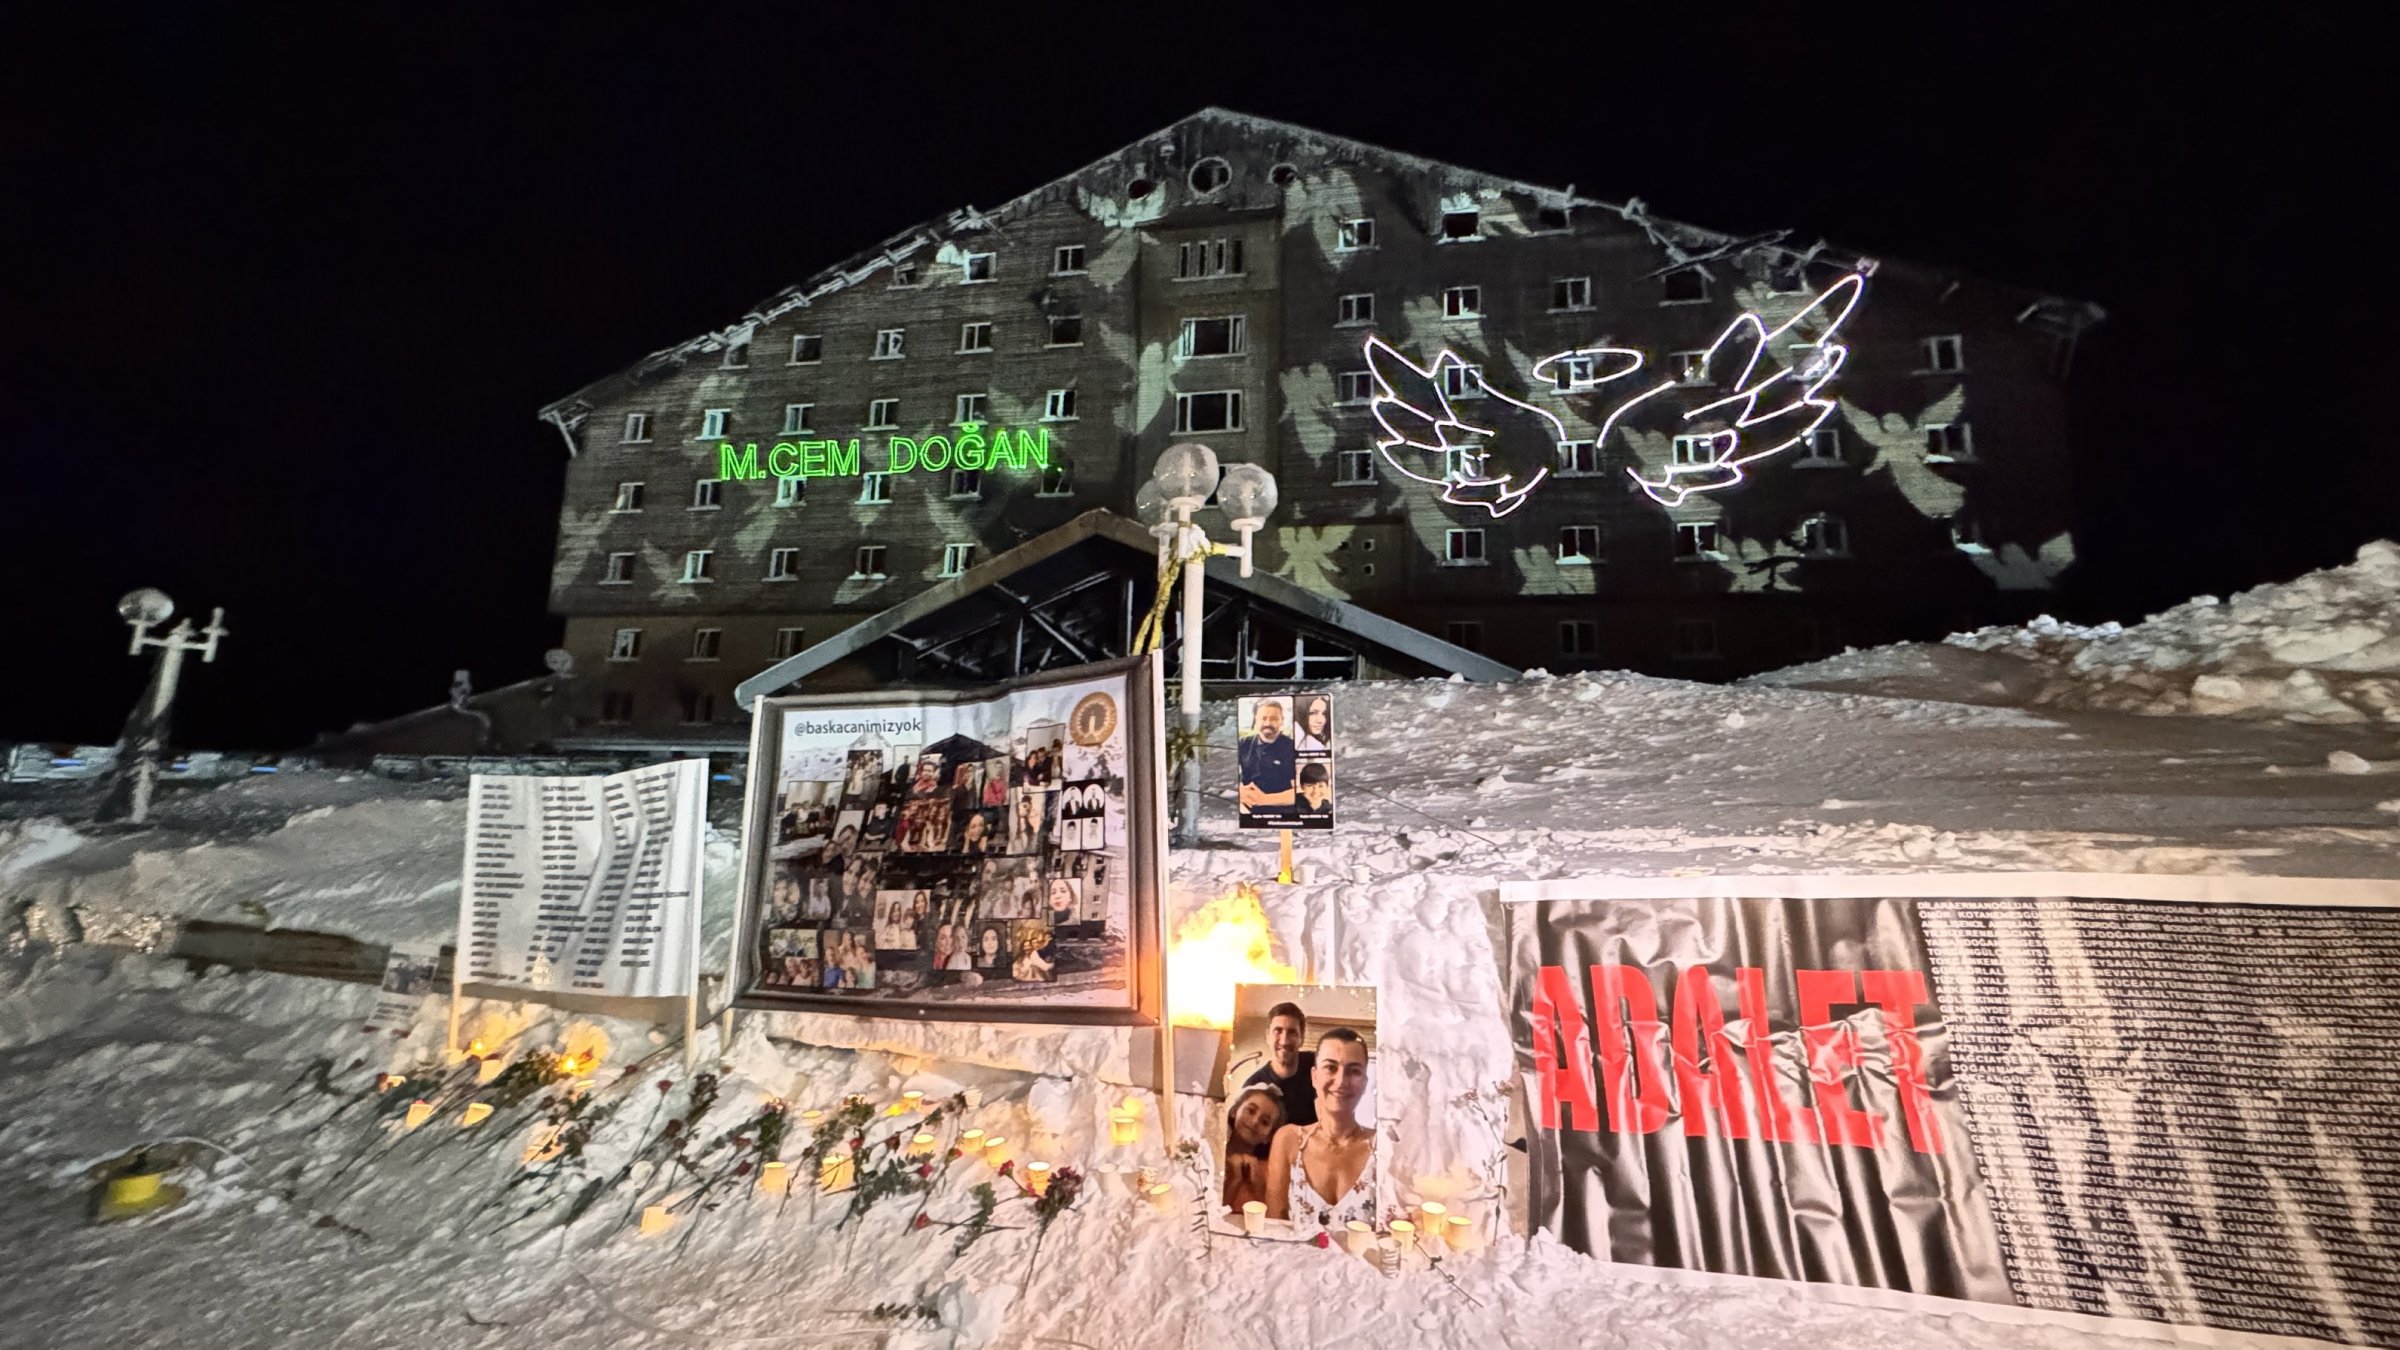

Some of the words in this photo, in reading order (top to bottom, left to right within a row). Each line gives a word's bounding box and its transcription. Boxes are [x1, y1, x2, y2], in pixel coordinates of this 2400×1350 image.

[720, 439, 860, 481] M.CEM
[889, 422, 1049, 474] DOĞAN
[794, 717, 922, 738] @baskacanimizyok
[1532, 965, 1947, 1155] ADALET
